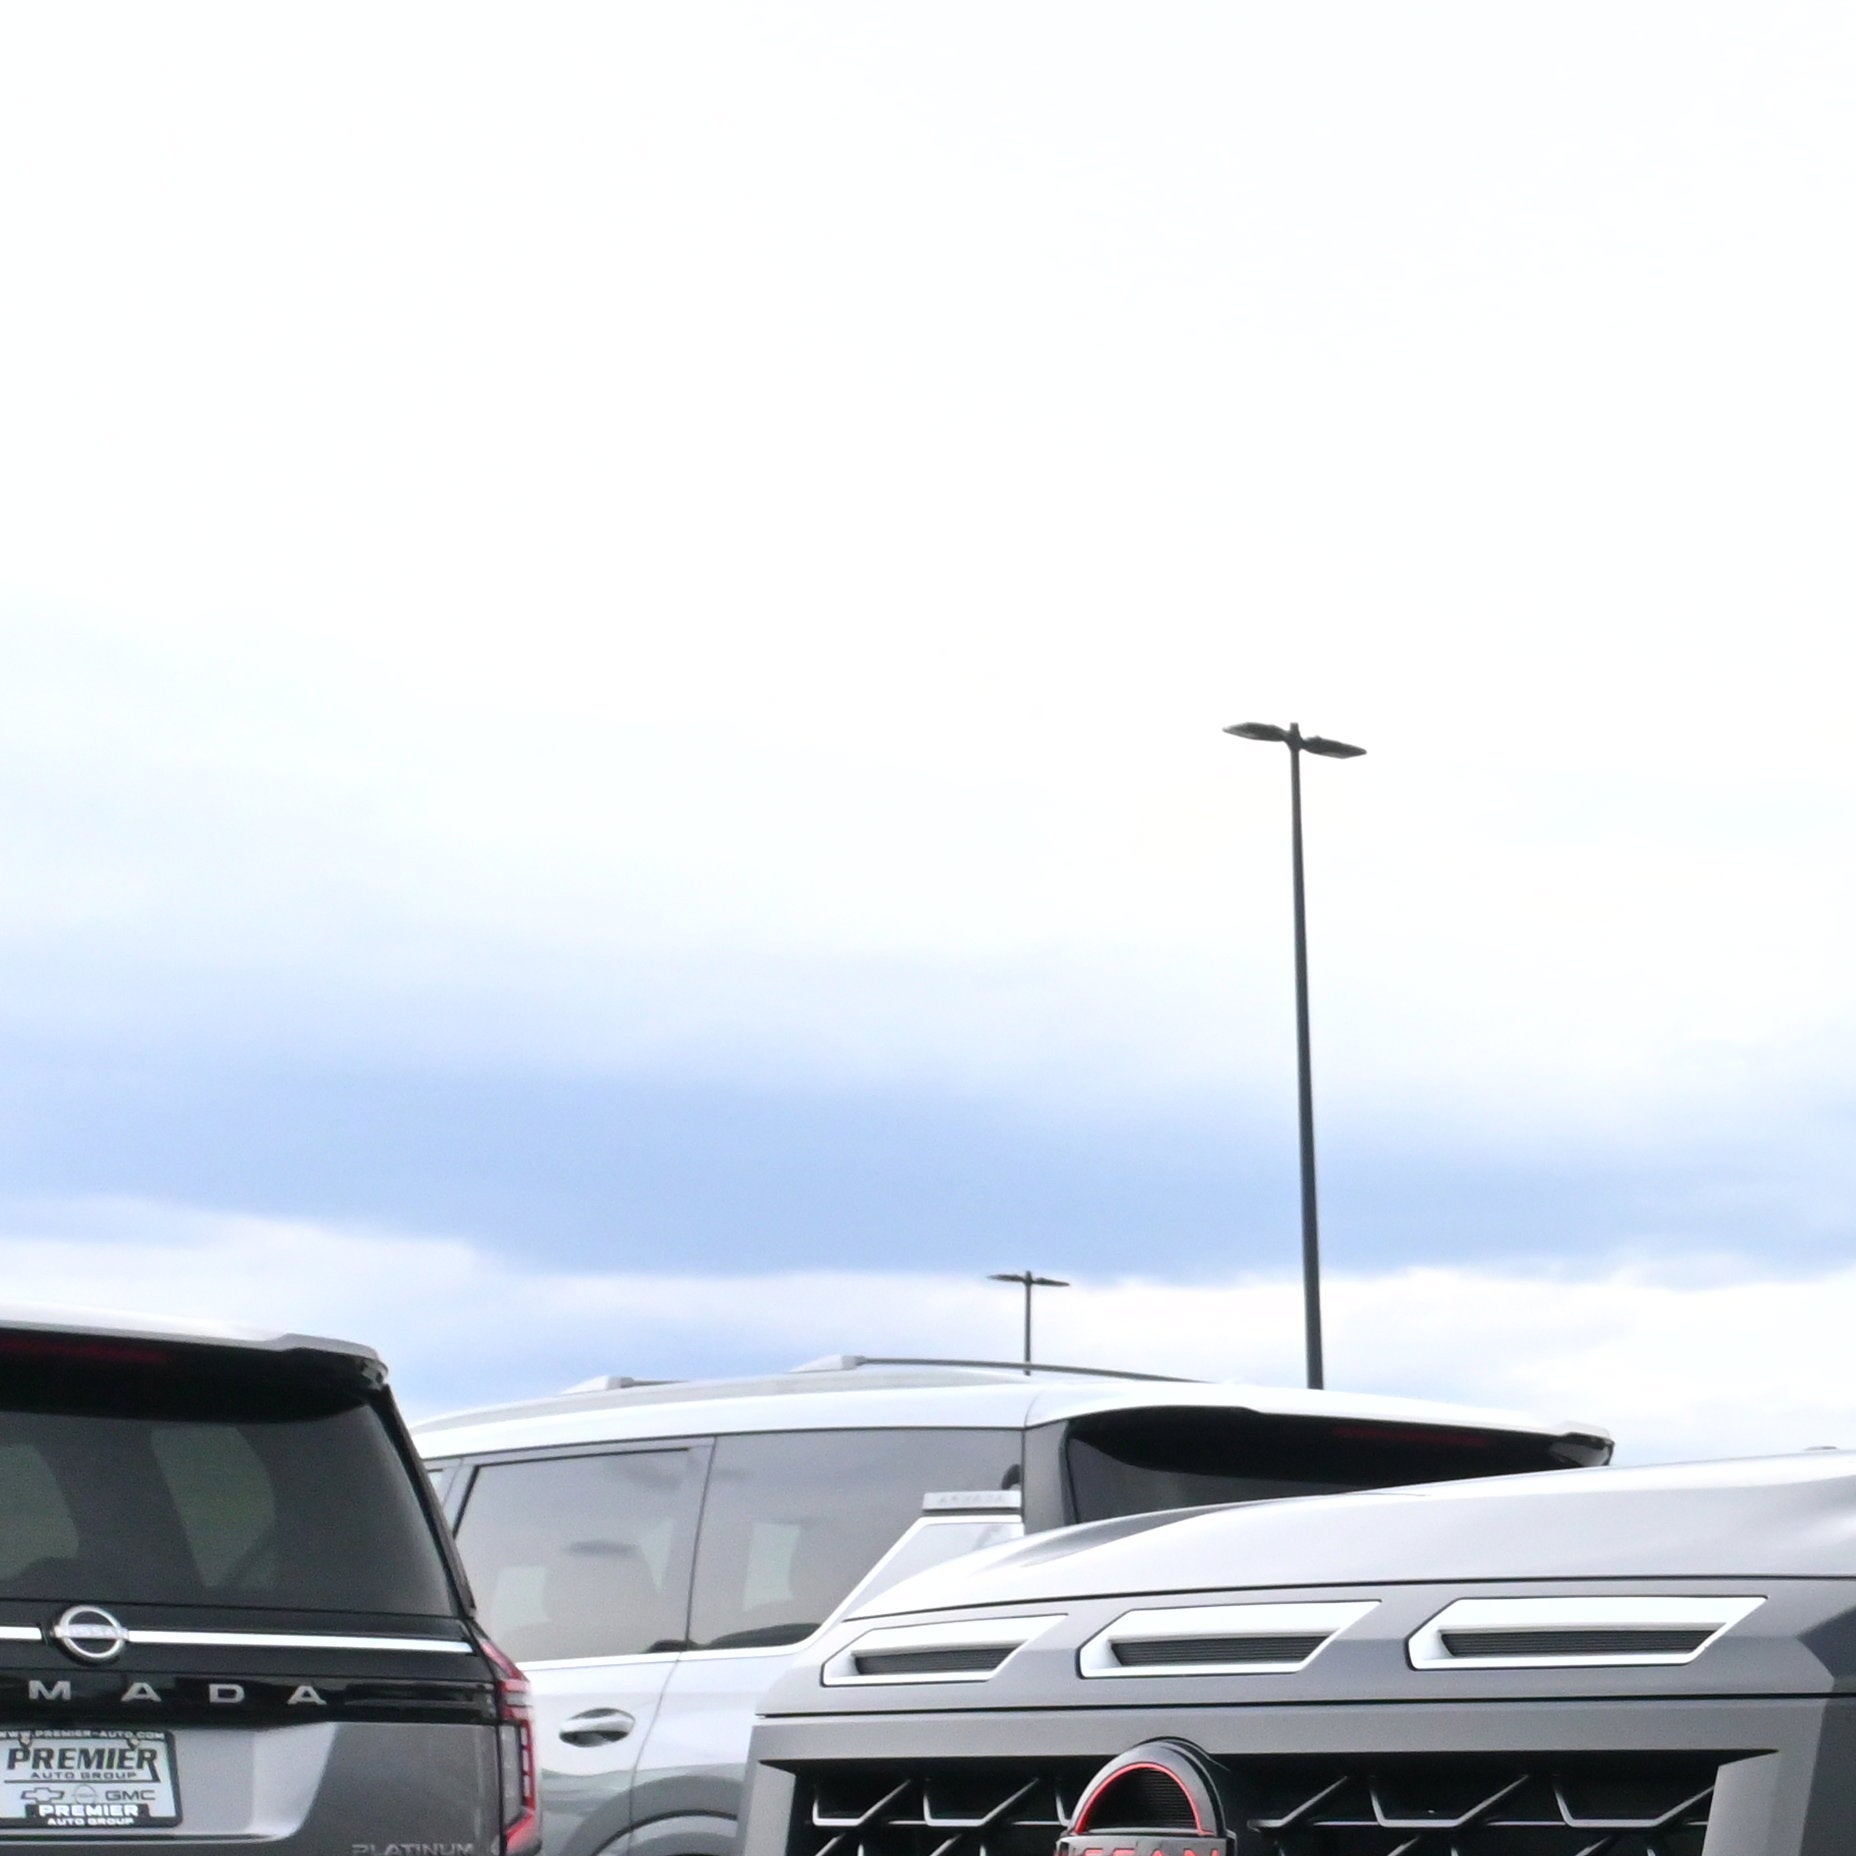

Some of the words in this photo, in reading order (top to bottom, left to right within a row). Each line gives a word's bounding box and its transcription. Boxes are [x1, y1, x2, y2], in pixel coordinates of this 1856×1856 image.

[28, 1680, 328, 1705] MADA
[0, 1730, 165, 1740] WWW.PREMIER-AUTO.COM
[7, 1747, 161, 1779] PREMIER
[31, 1771, 75, 1779] AUTO
[105, 1790, 156, 1801] GMC
[38, 1804, 139, 1817] PREMIER
[47, 1817, 85, 1825] AUTO
[87, 1817, 135, 1825] GROUP
[351, 1843, 475, 1856] PLATINUM
